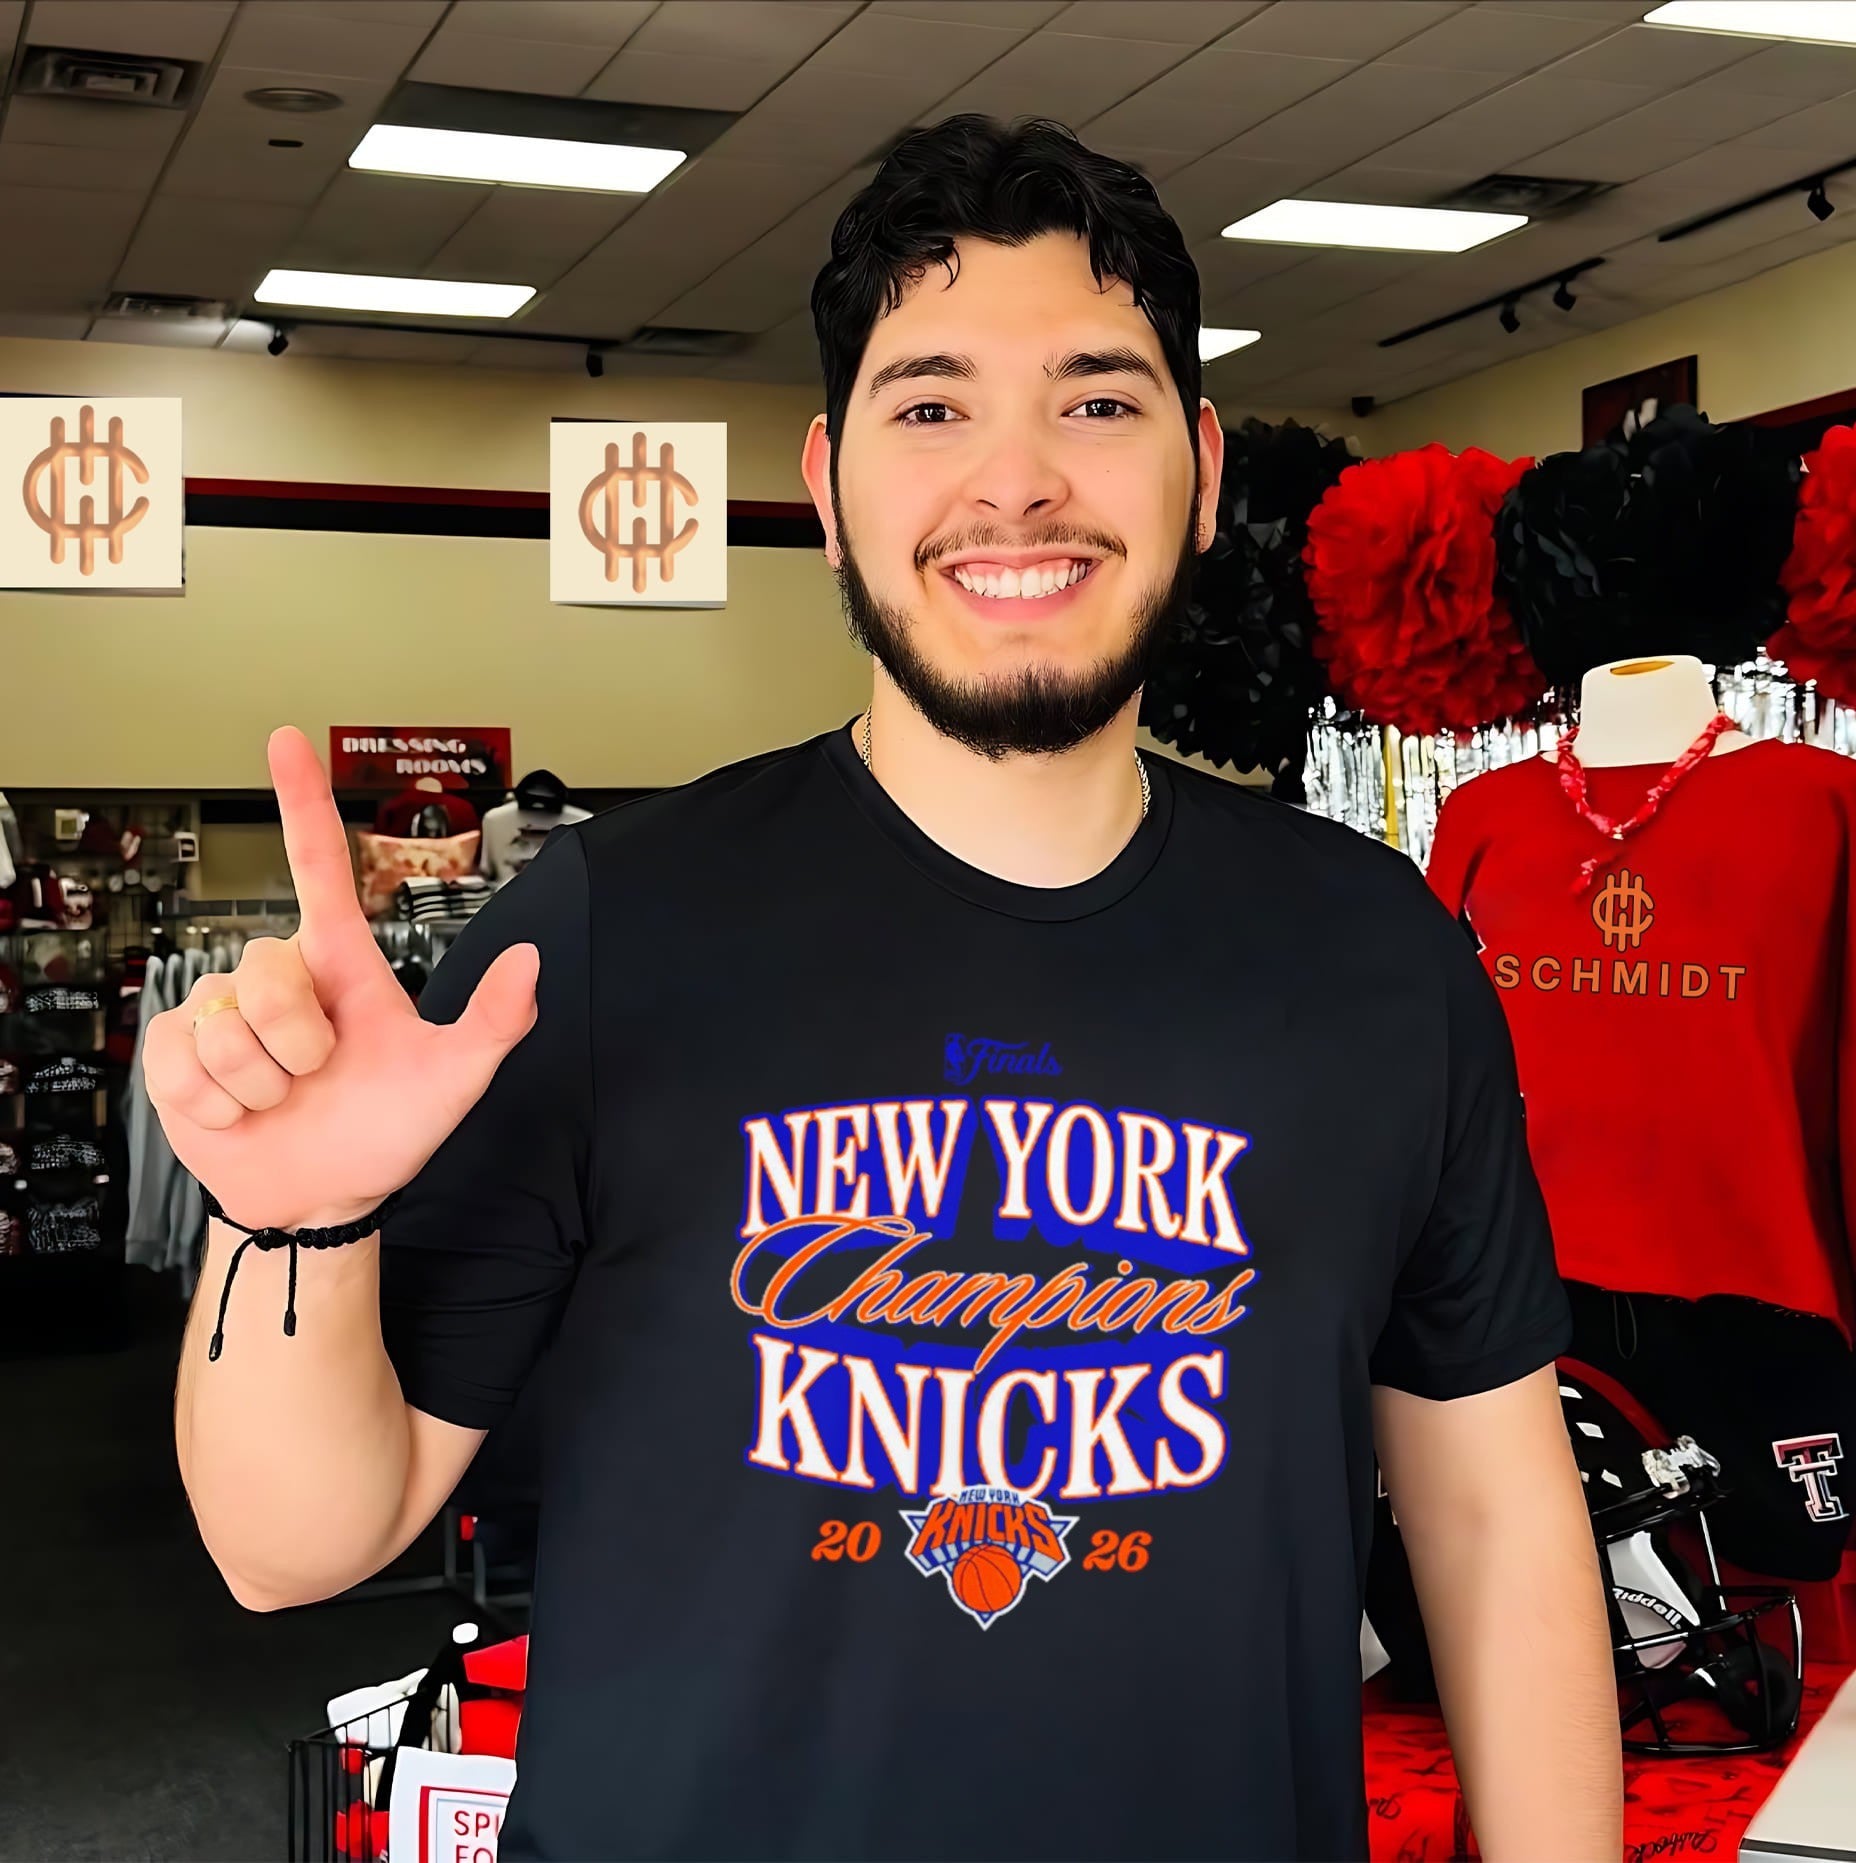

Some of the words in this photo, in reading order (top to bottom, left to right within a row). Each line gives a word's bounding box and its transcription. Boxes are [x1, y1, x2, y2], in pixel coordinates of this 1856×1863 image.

[342, 737, 467, 754] DRESSING
[396, 758, 487, 775] ROOMS
[1494, 954, 1747, 1000] SCHMIDT
[957, 1037, 1063, 1086] Finals
[740, 1098, 970, 1239] NEW
[985, 1099, 1250, 1256] YORK
[730, 1215, 1256, 1373] Champions
[749, 1333, 1227, 1498] KNICKS
[958, 1489, 986, 1502] NEW
[989, 1489, 1020, 1503] YORK
[810, 1520, 882, 1563] 20
[910, 1498, 1065, 1562] KNICKS
[1082, 1529, 1153, 1573] 26
